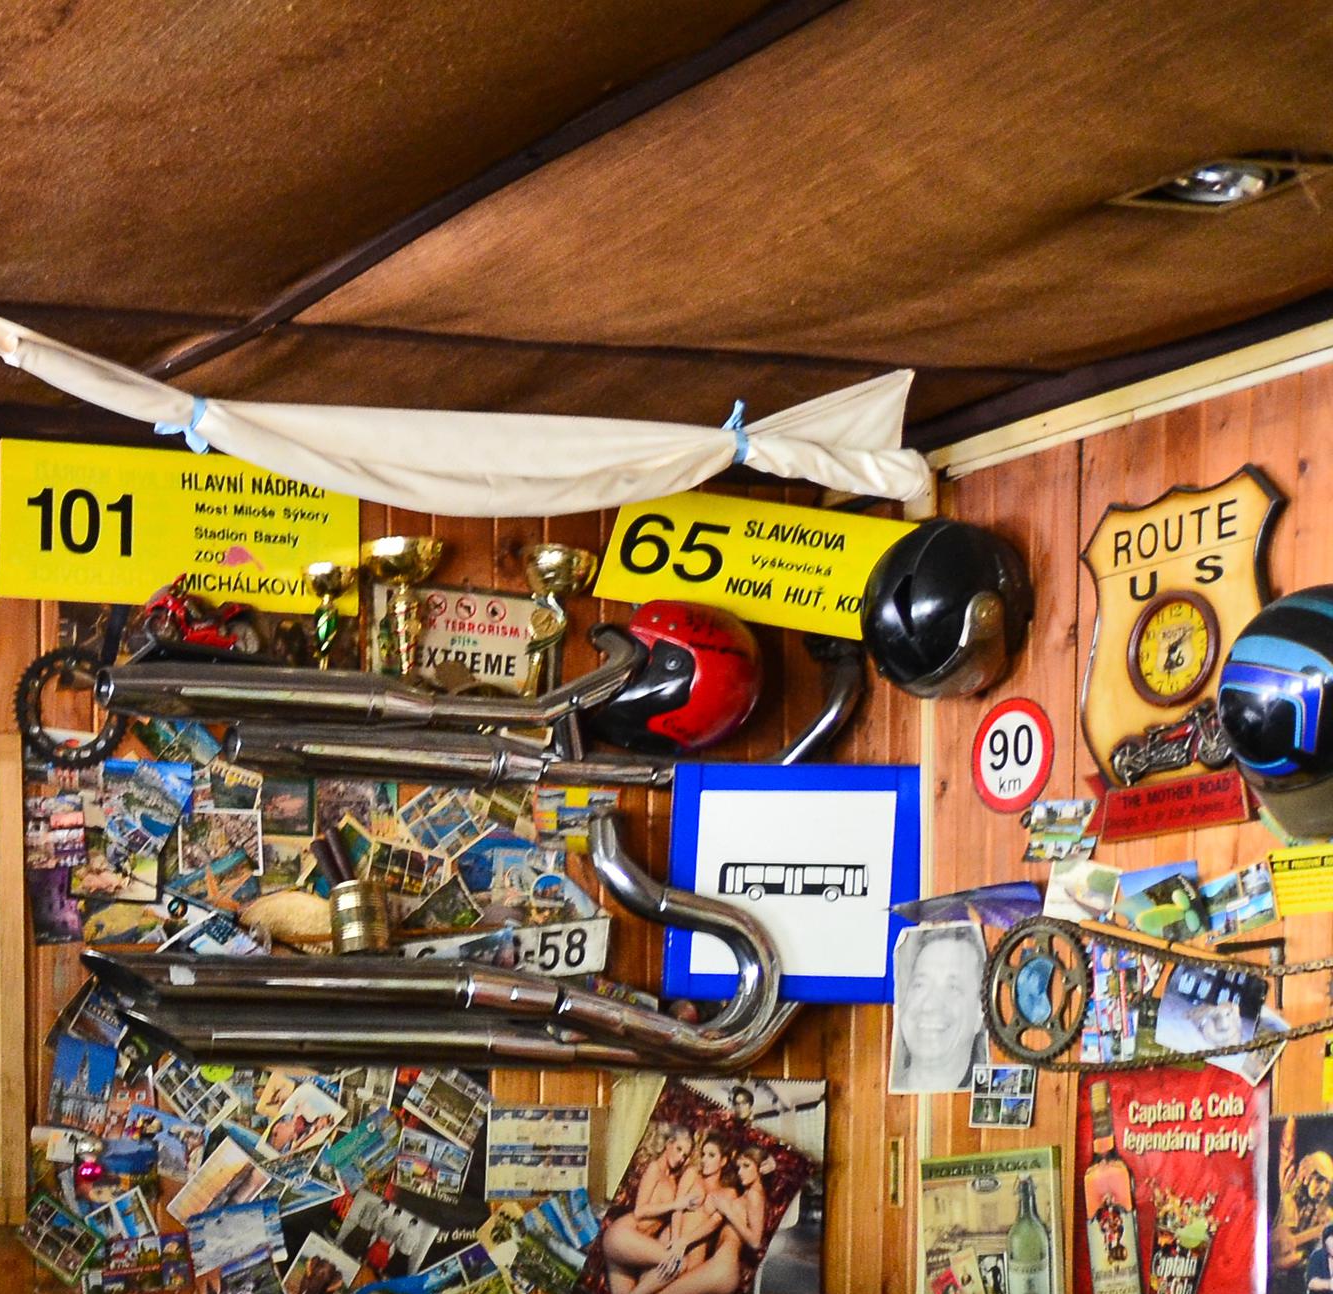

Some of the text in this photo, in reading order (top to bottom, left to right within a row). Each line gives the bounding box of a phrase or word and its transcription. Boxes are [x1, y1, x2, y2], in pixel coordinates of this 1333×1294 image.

[180, 471, 244, 495] HLAVNÍ
[26, 486, 134, 558] 101
[194, 502, 330, 524] Most Miloše Sýkory
[193, 526, 300, 549] Stadion Bazaly
[619, 512, 732, 584] 65
[743, 519, 847, 552] SLAVÍKOVA
[1113, 498, 1239, 568] ROUTE
[194, 549, 227, 564] ZOO
[181, 570, 307, 598] MICHÁLKOVI
[1129, 554, 1226, 602] U S
[724, 575, 773, 601] NOVÁ
[834, 593, 865, 615] KO
[988, 723, 1035, 772] 90
[998, 776, 1023, 794] km
[1127, 1092, 1246, 1128] Captain & Cola
[1122, 1125, 1203, 1155] legendární
